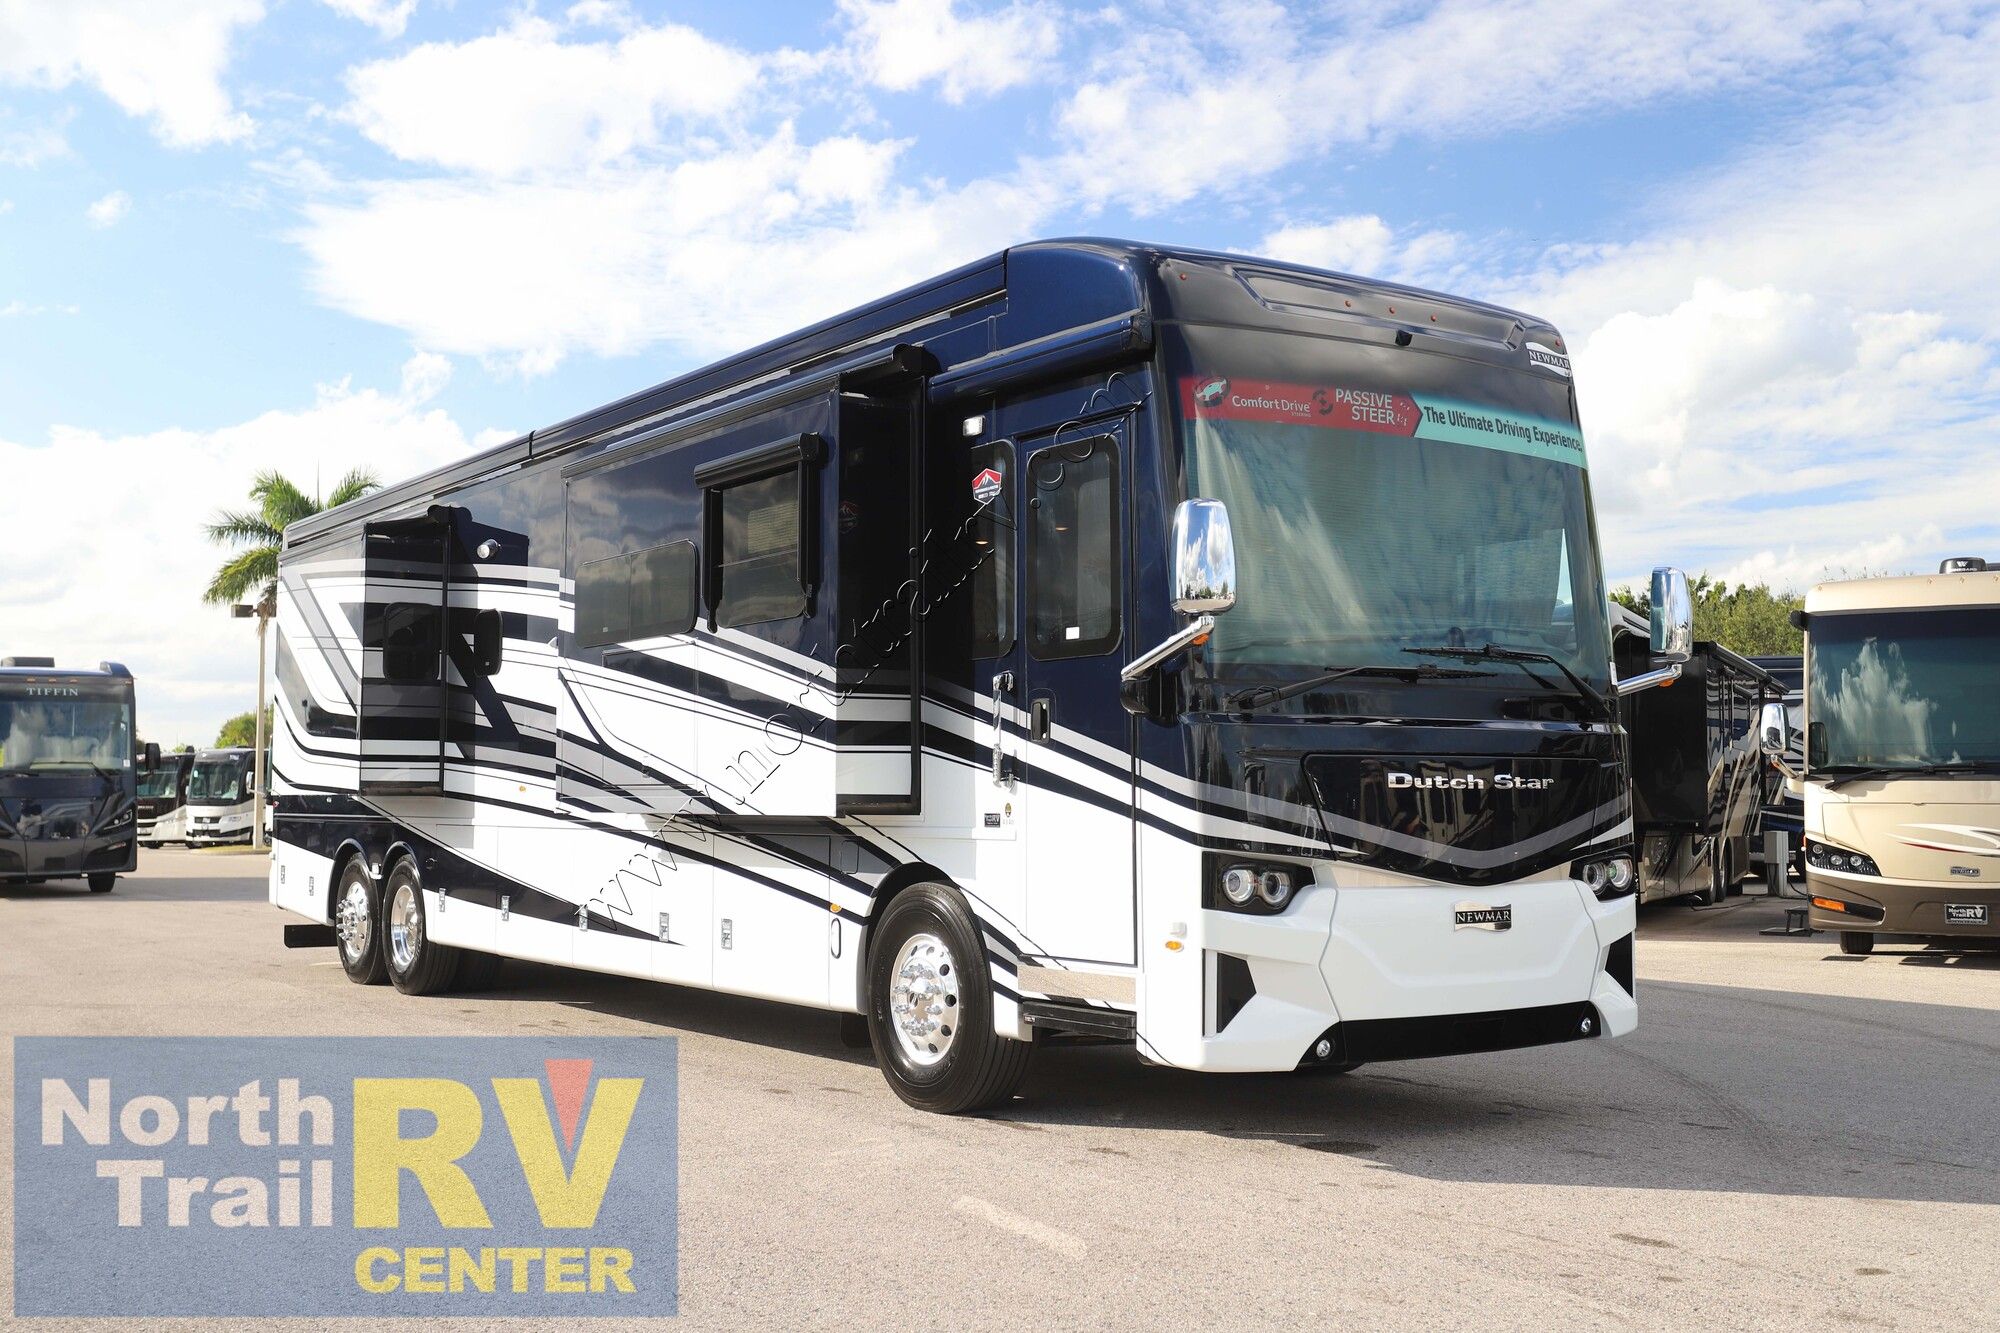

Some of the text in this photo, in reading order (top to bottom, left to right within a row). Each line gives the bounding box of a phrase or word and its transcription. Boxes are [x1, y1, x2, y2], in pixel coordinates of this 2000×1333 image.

[1528, 350, 1570, 369] NEWMAR
[1232, 395, 1311, 412] Comfort Drive
[1335, 388, 1393, 409] PASSIVE
[1351, 406, 1396, 425] STEER
[1423, 406, 1446, 424] The
[1447, 410, 1494, 433] Ultimate
[1495, 418, 1532, 443] Driving
[25, 687, 79, 696] TIFFIN
[1387, 772, 1555, 790] Dutch Star
[1456, 910, 1512, 923] NEWMAR
[1966, 907, 1984, 918] RV
